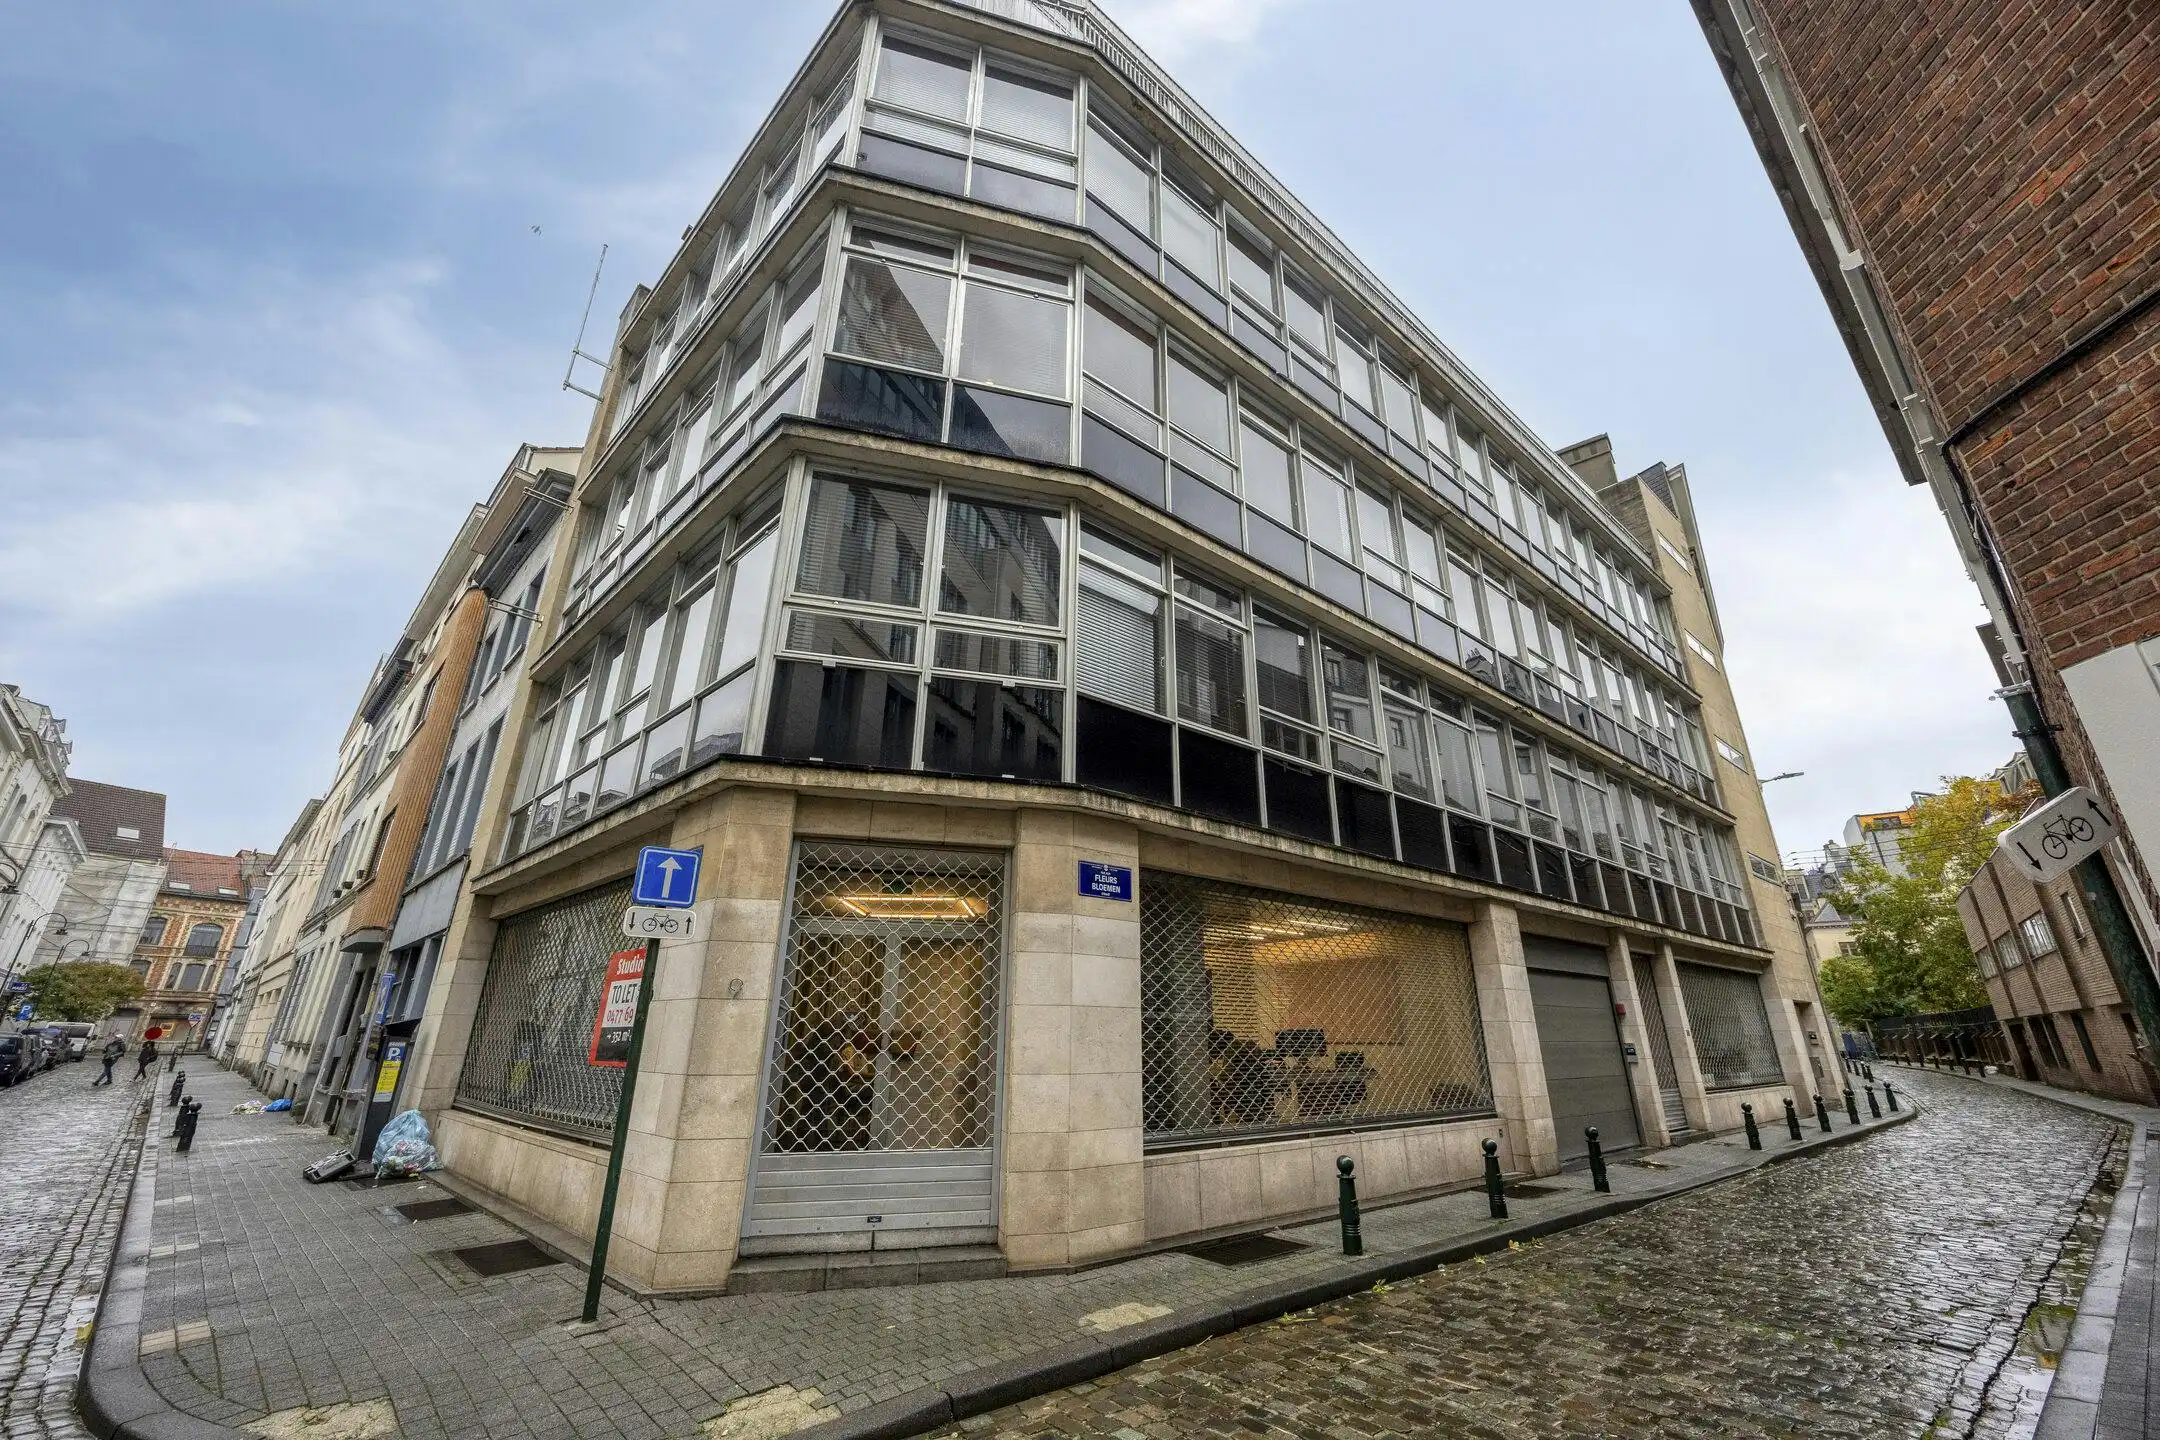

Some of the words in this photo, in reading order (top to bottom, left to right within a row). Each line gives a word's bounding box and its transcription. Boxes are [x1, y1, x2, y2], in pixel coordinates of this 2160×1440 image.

[1094, 874, 1118, 884] FLEURS
[1091, 883, 1121, 893] BLOEMEN
[616, 954, 645, 975] Studio
[624, 1006, 634, 1023] 69
[387, 1047, 400, 1060] P
